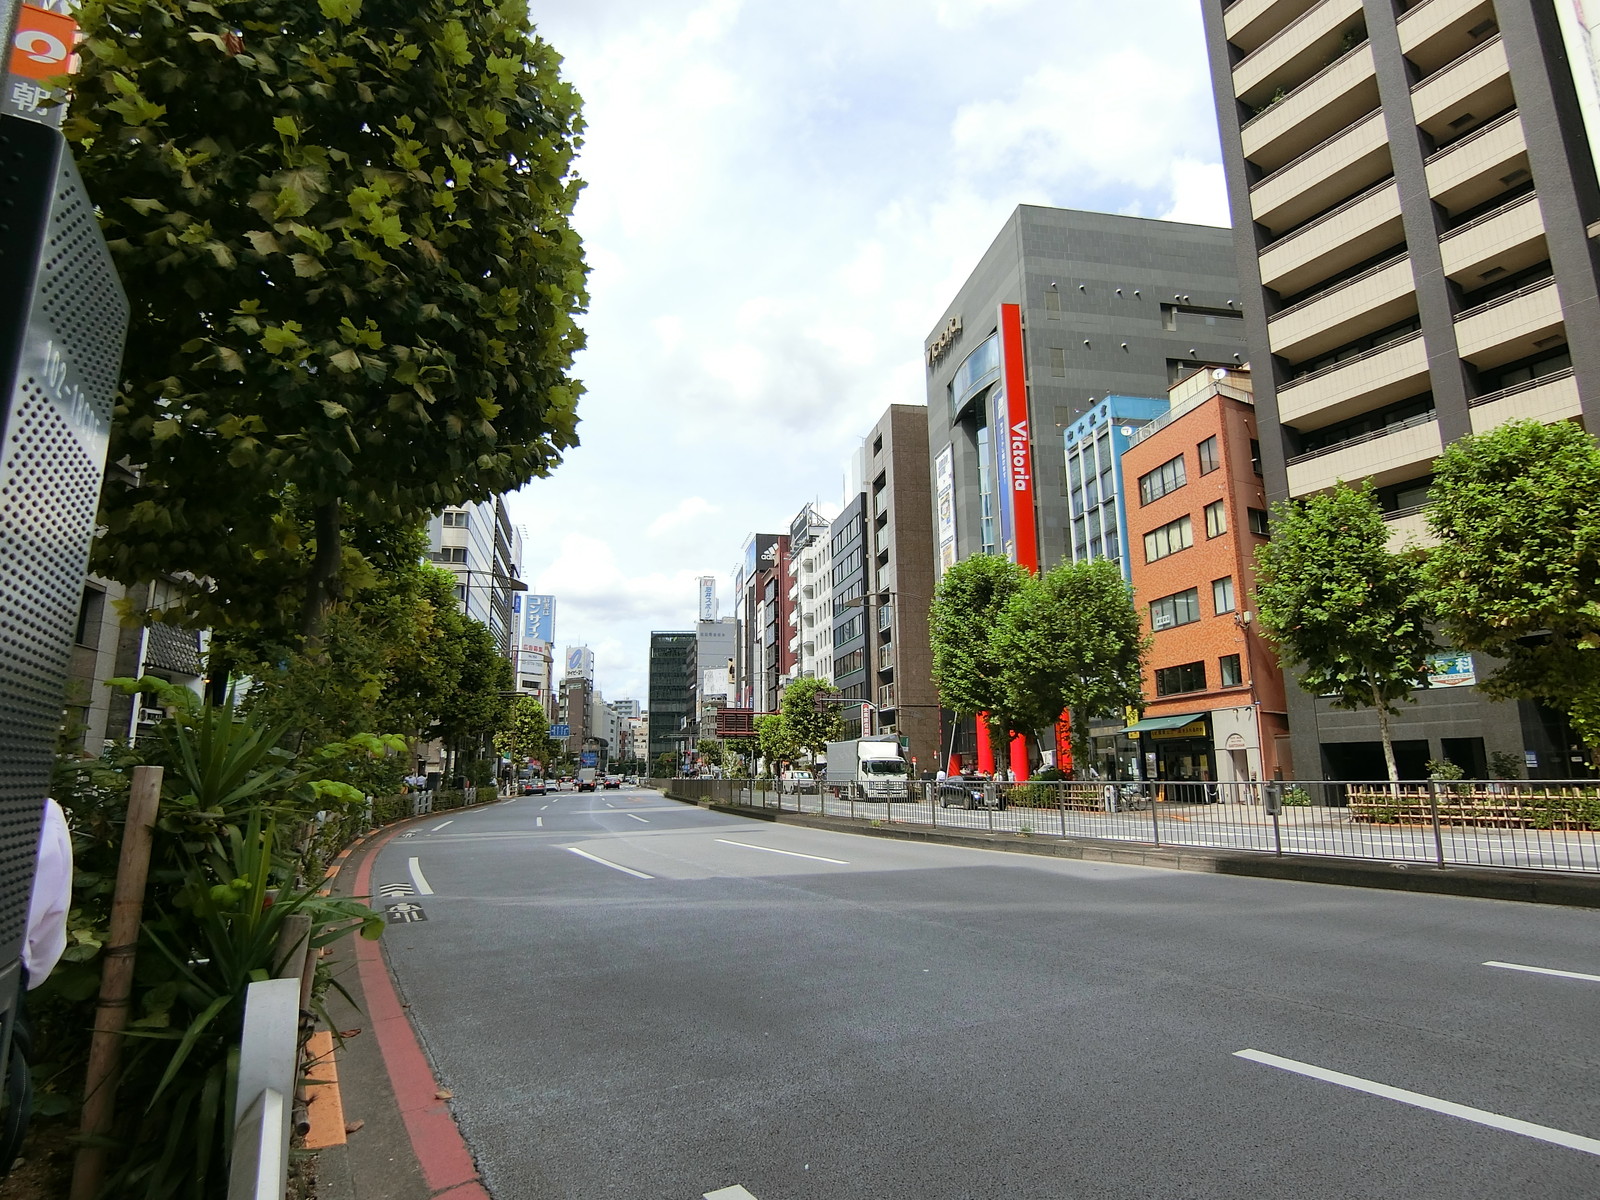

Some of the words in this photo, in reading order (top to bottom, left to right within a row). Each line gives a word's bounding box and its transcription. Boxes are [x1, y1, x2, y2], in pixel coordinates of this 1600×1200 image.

[11, 82, 52, 123] 朝
[1011, 421, 1029, 490] Victoria
[704, 587, 713, 619] 石井スポーツ
